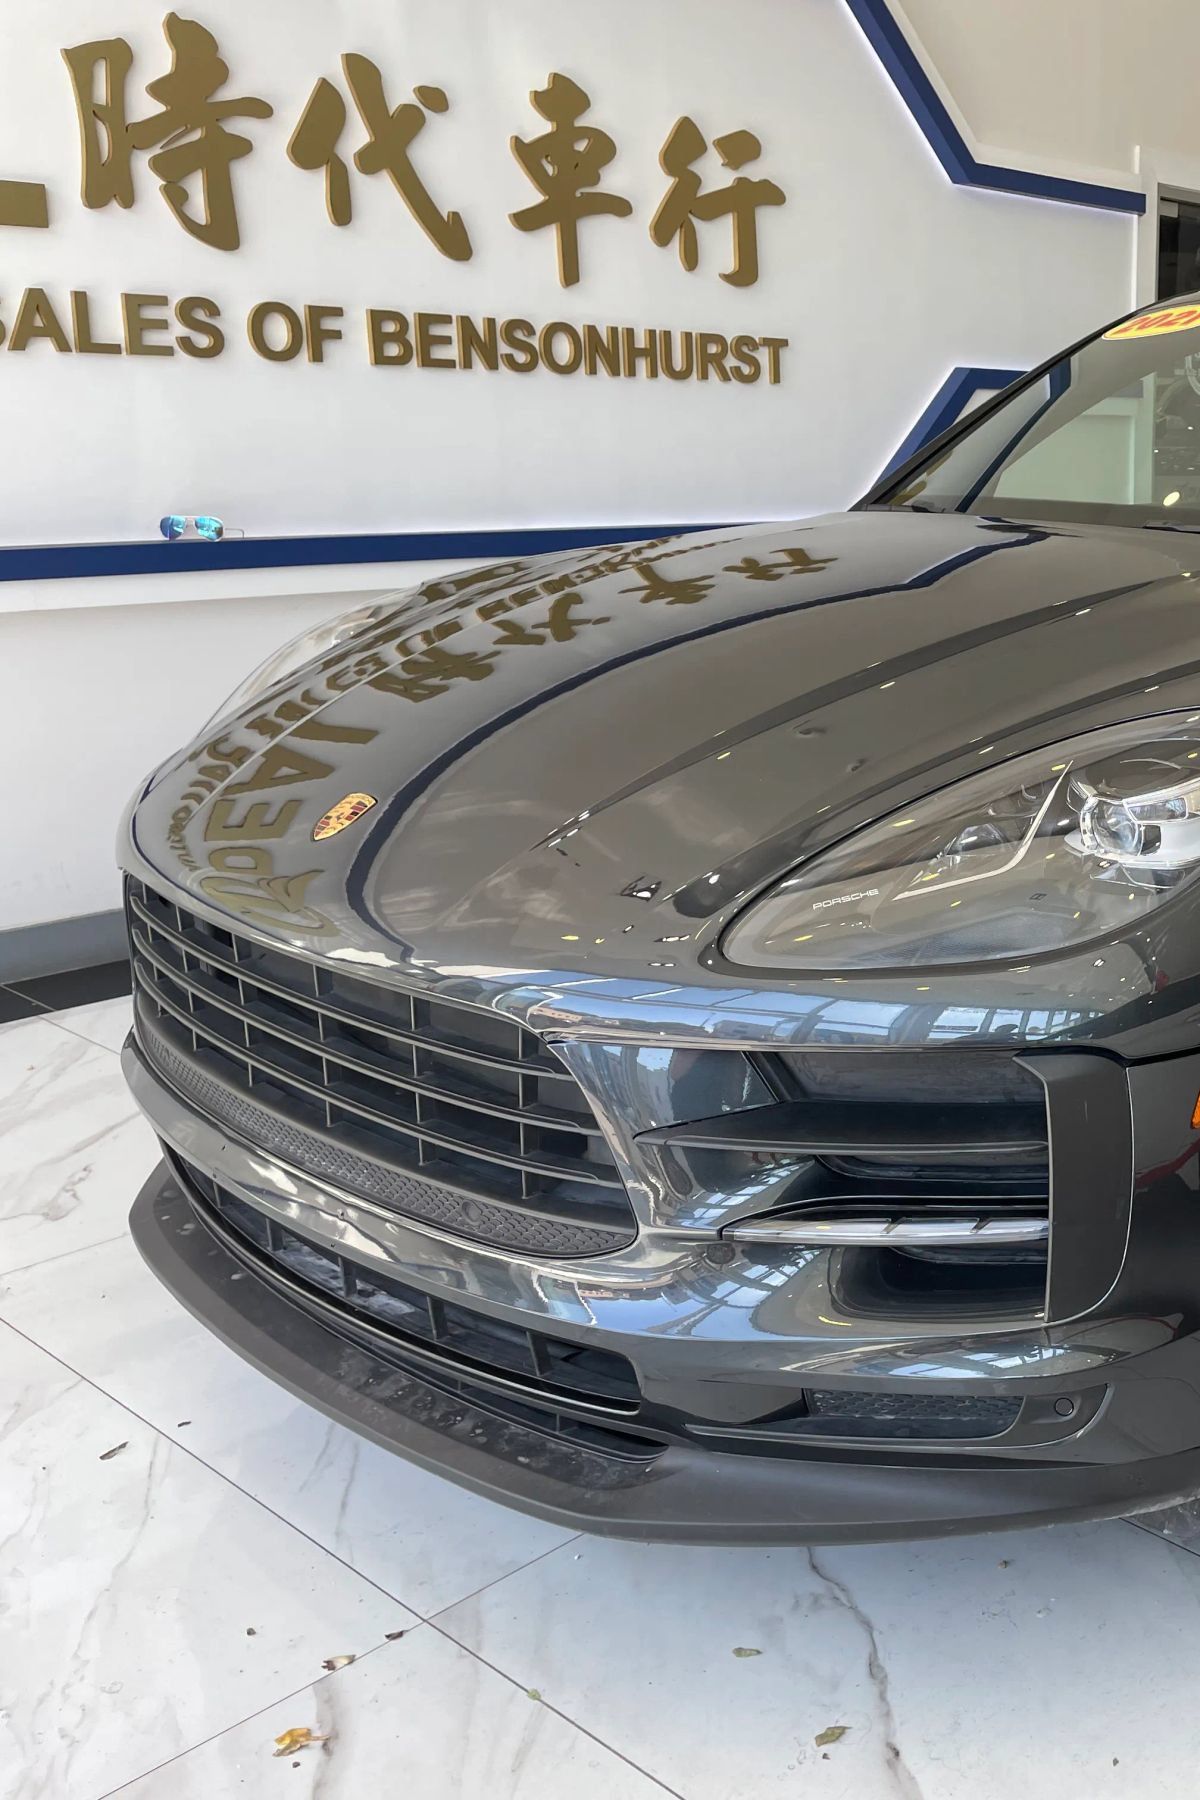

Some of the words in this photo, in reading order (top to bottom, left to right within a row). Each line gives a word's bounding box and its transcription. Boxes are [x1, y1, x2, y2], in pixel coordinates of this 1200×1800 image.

[61, 11, 787, 289] 時代車行
[0, 286, 225, 358] ALES
[247, 301, 343, 364] OF
[366, 308, 789, 386] BENSONHURST
[812, 888, 879, 911] PORSCHE
